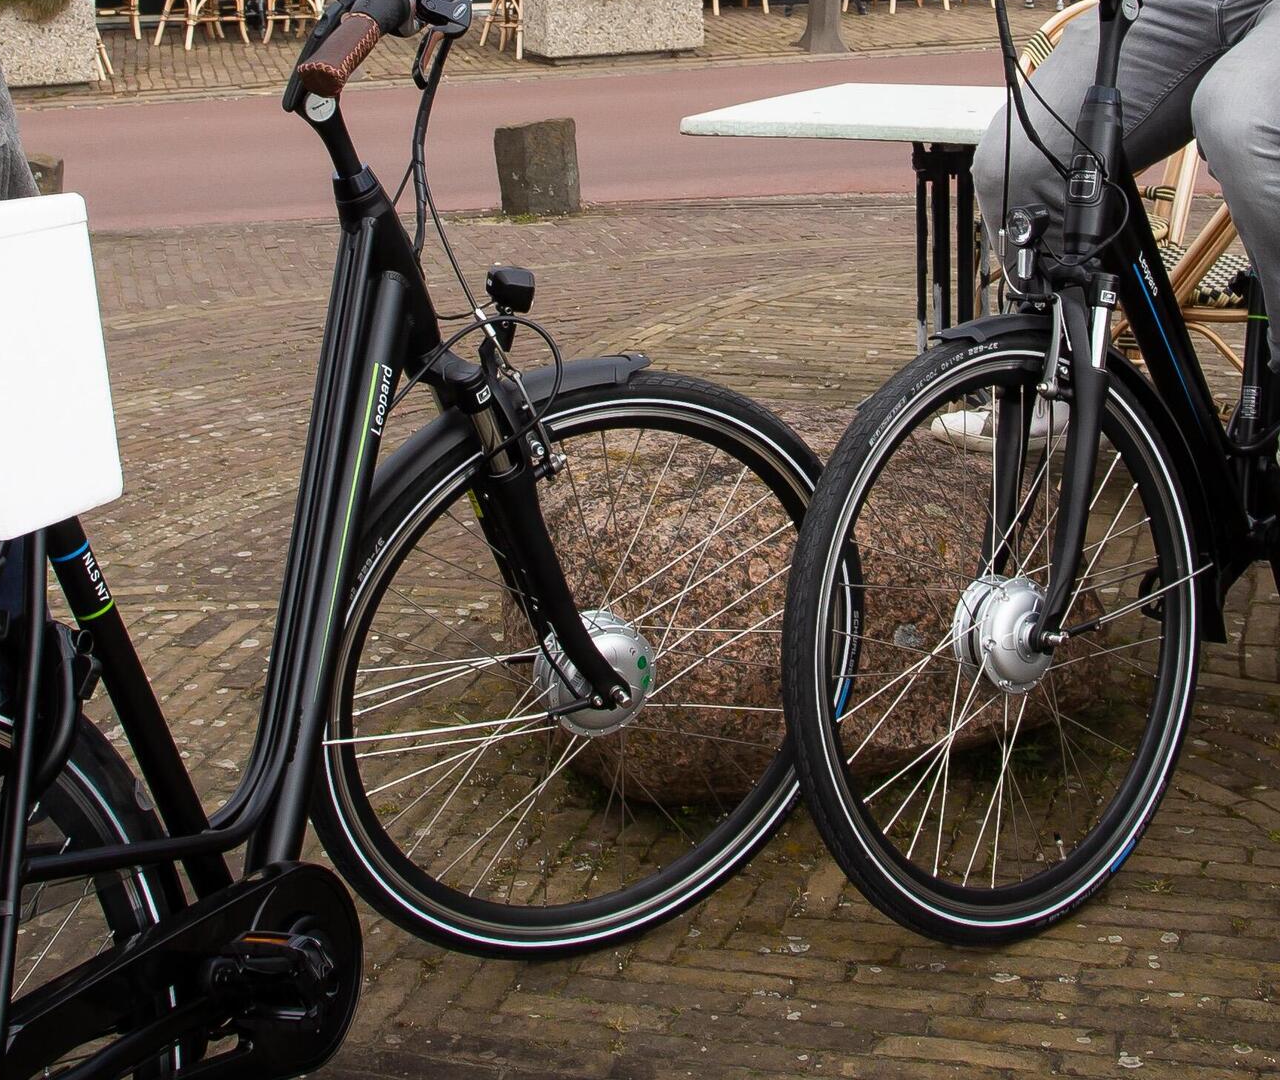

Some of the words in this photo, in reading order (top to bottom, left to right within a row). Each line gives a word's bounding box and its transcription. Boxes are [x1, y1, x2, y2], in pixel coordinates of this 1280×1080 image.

[370, 364, 393, 436] Leopard
[82, 551, 101, 582] NLS
[95, 581, 110, 602] N7
